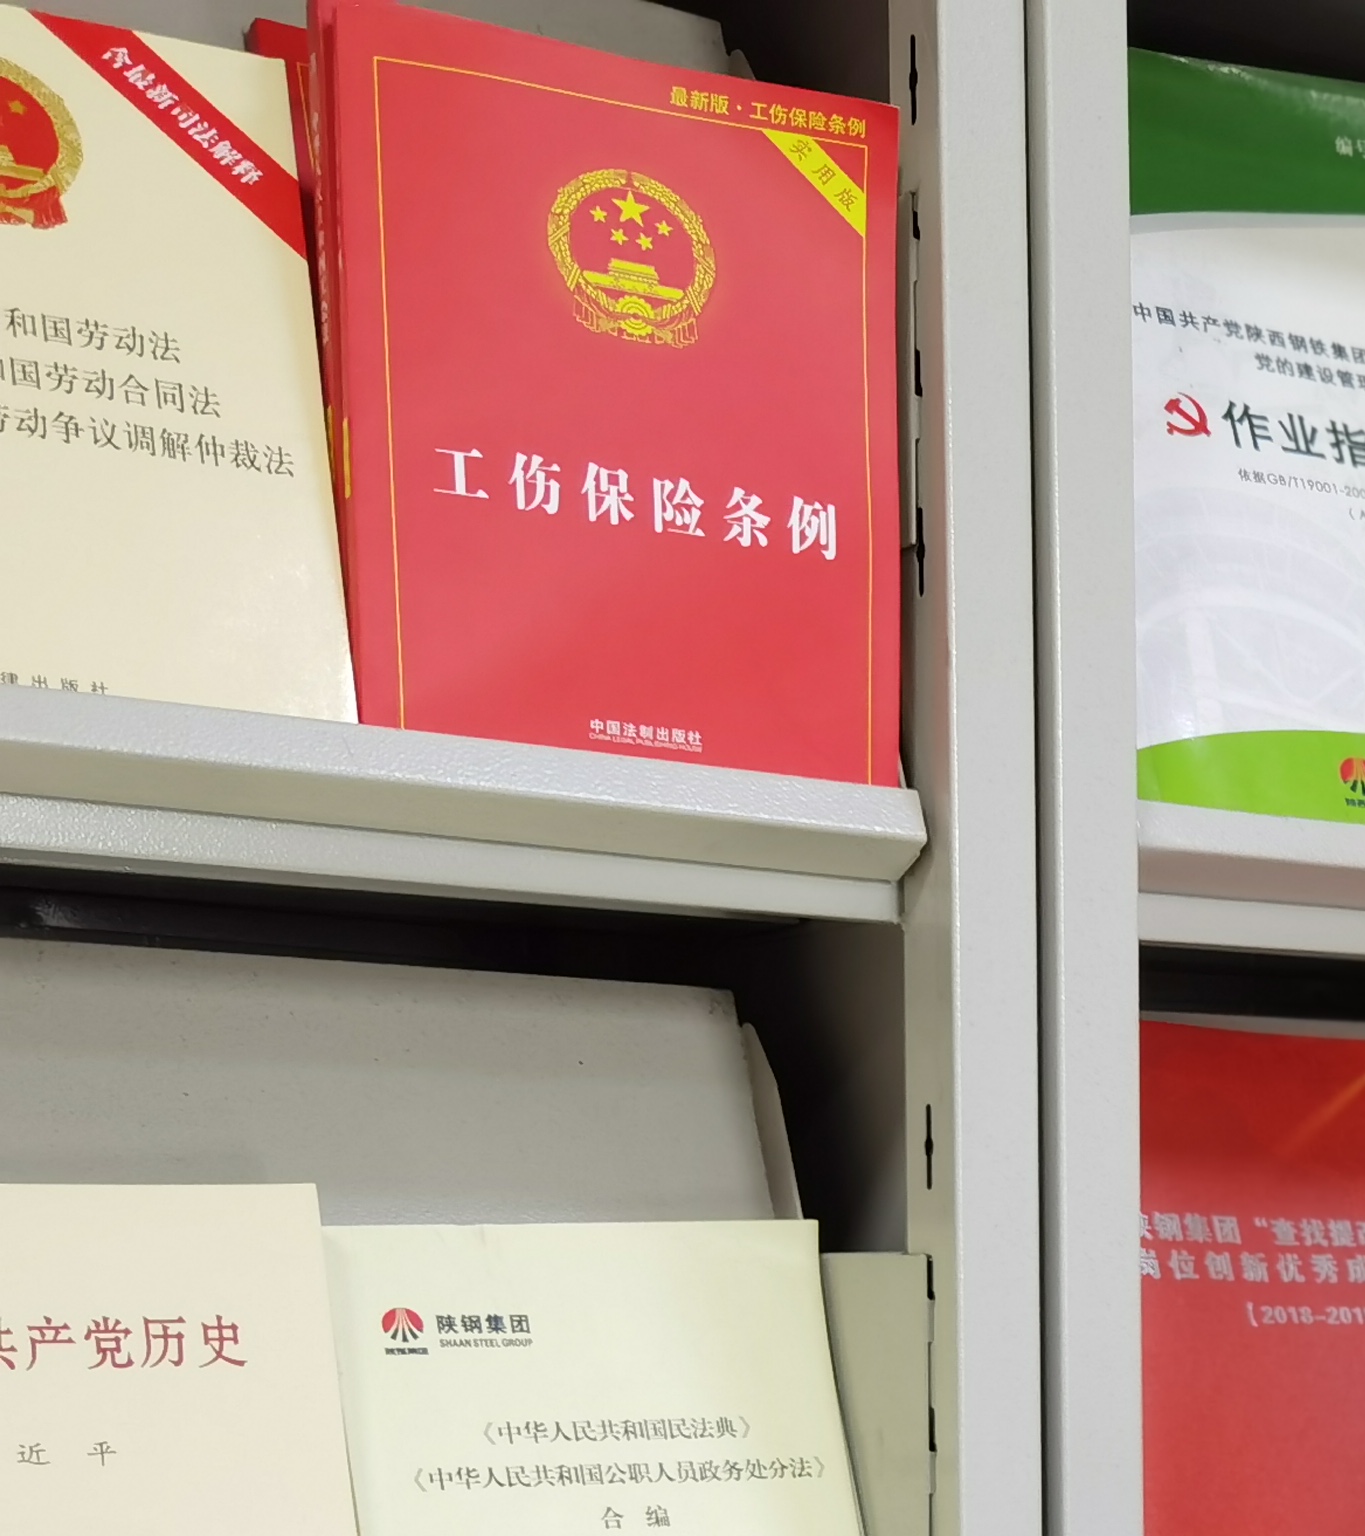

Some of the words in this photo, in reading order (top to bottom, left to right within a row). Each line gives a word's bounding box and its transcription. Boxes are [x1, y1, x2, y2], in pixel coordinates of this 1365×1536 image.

[101, 45, 265, 187] 含最新司法解释
[788, 140, 860, 214] 实用版
[3, 307, 181, 364] 和国劳动法
[0, 356, 221, 418] 国劳动合同法
[432, 446, 839, 561] 工伤保险条例
[590, 719, 703, 745] 中国法制出版社
[436, 1313, 531, 1335] 陕钢集团
[440, 1338, 472, 1348] SHAAN
[473, 1338, 500, 1348] STEEL
[501, 1338, 534, 1347] GROUP
[480, 1415, 753, 1446] 《中华人民共和国民法典》
[411, 1454, 828, 1493] 《中华人民共和国公职人员政务处分法》
[600, 1505, 671, 1531] 合编
